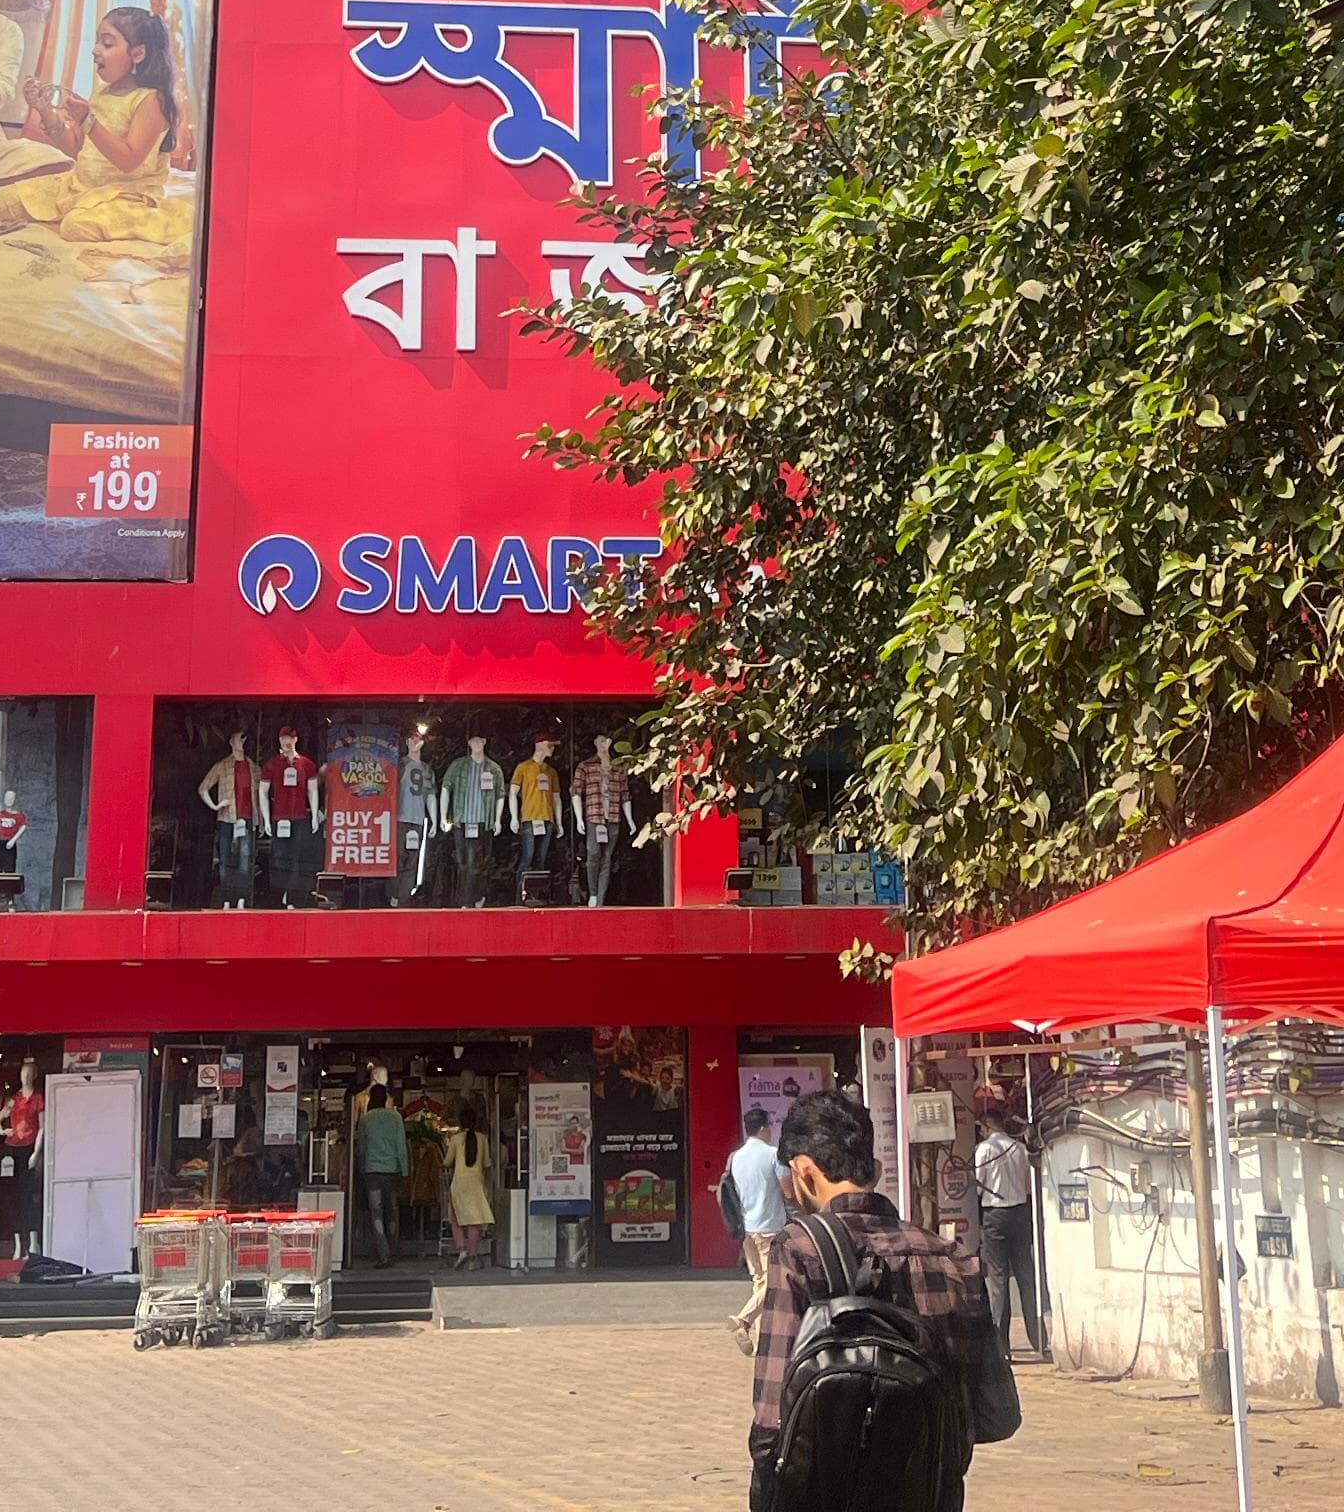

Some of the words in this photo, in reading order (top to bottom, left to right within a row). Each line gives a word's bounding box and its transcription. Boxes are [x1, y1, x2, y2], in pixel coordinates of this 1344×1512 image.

[82, 430, 161, 450] Fashion
[109, 451, 131, 469] at
[161, 529, 186, 539] Apply
[336, 533, 663, 614] SMART
[348, 761, 383, 774] PAISA
[340, 771, 390, 785] VASOOL
[331, 828, 373, 845] GET
[332, 810, 373, 828] BUY
[373, 810, 391, 845] 1
[330, 845, 390, 865] FREE
